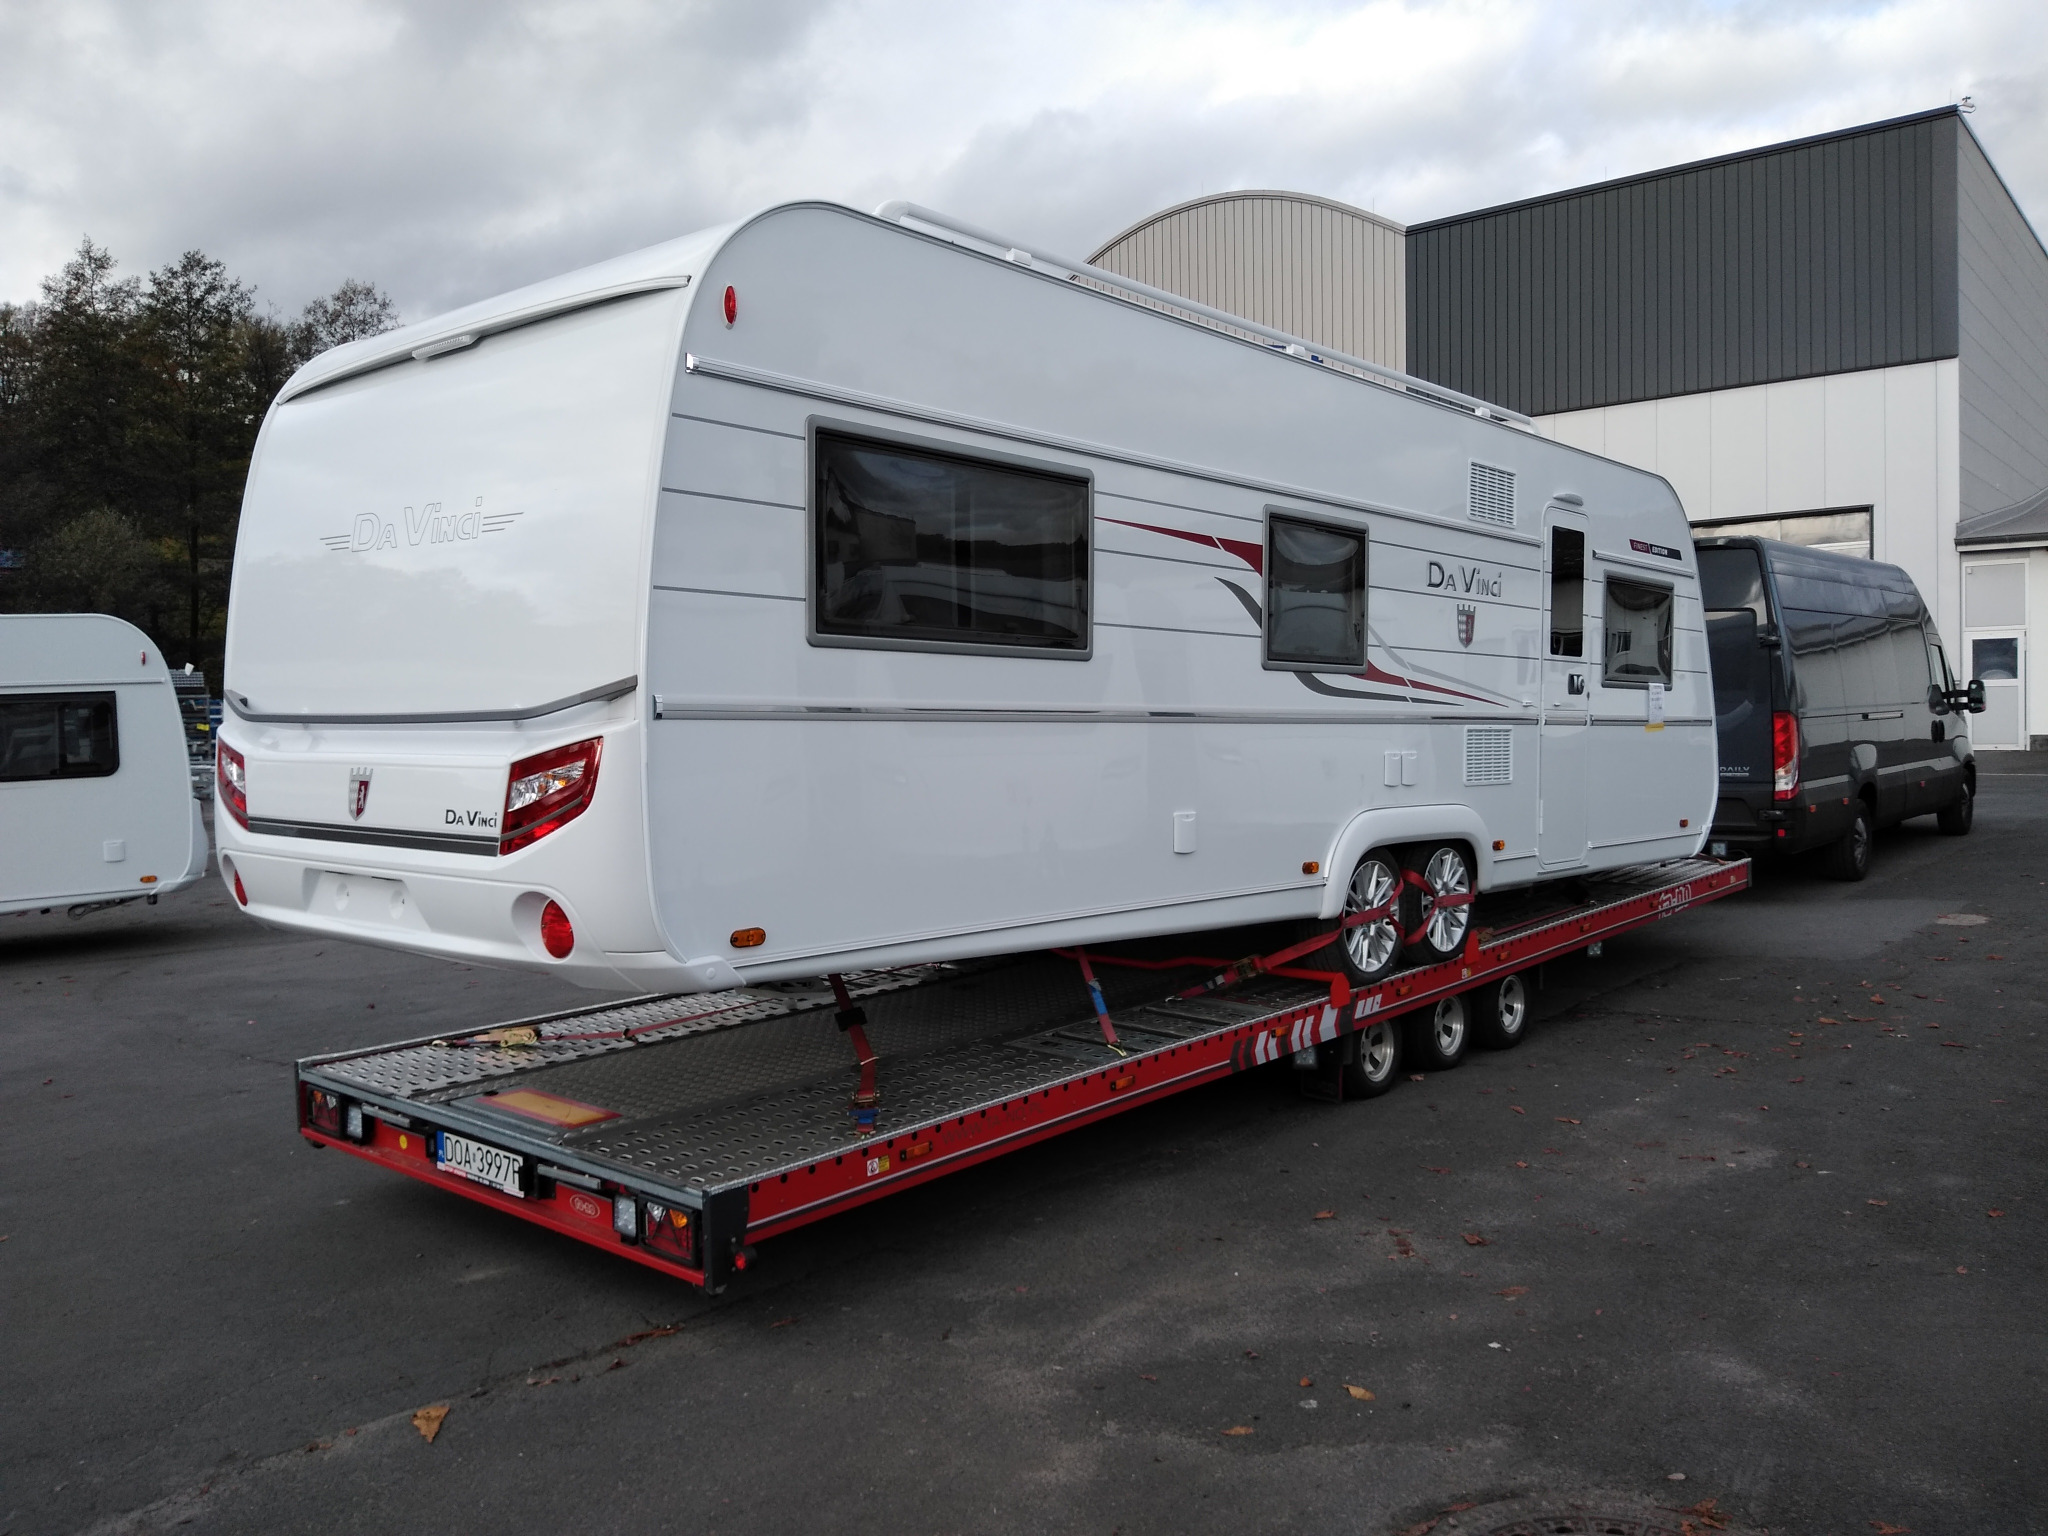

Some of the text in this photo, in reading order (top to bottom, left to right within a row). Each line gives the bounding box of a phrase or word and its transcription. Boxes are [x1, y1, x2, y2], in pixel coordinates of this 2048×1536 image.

[1633, 541, 1668, 556] FINEST EDITION
[444, 1136, 472, 1170] DOA
